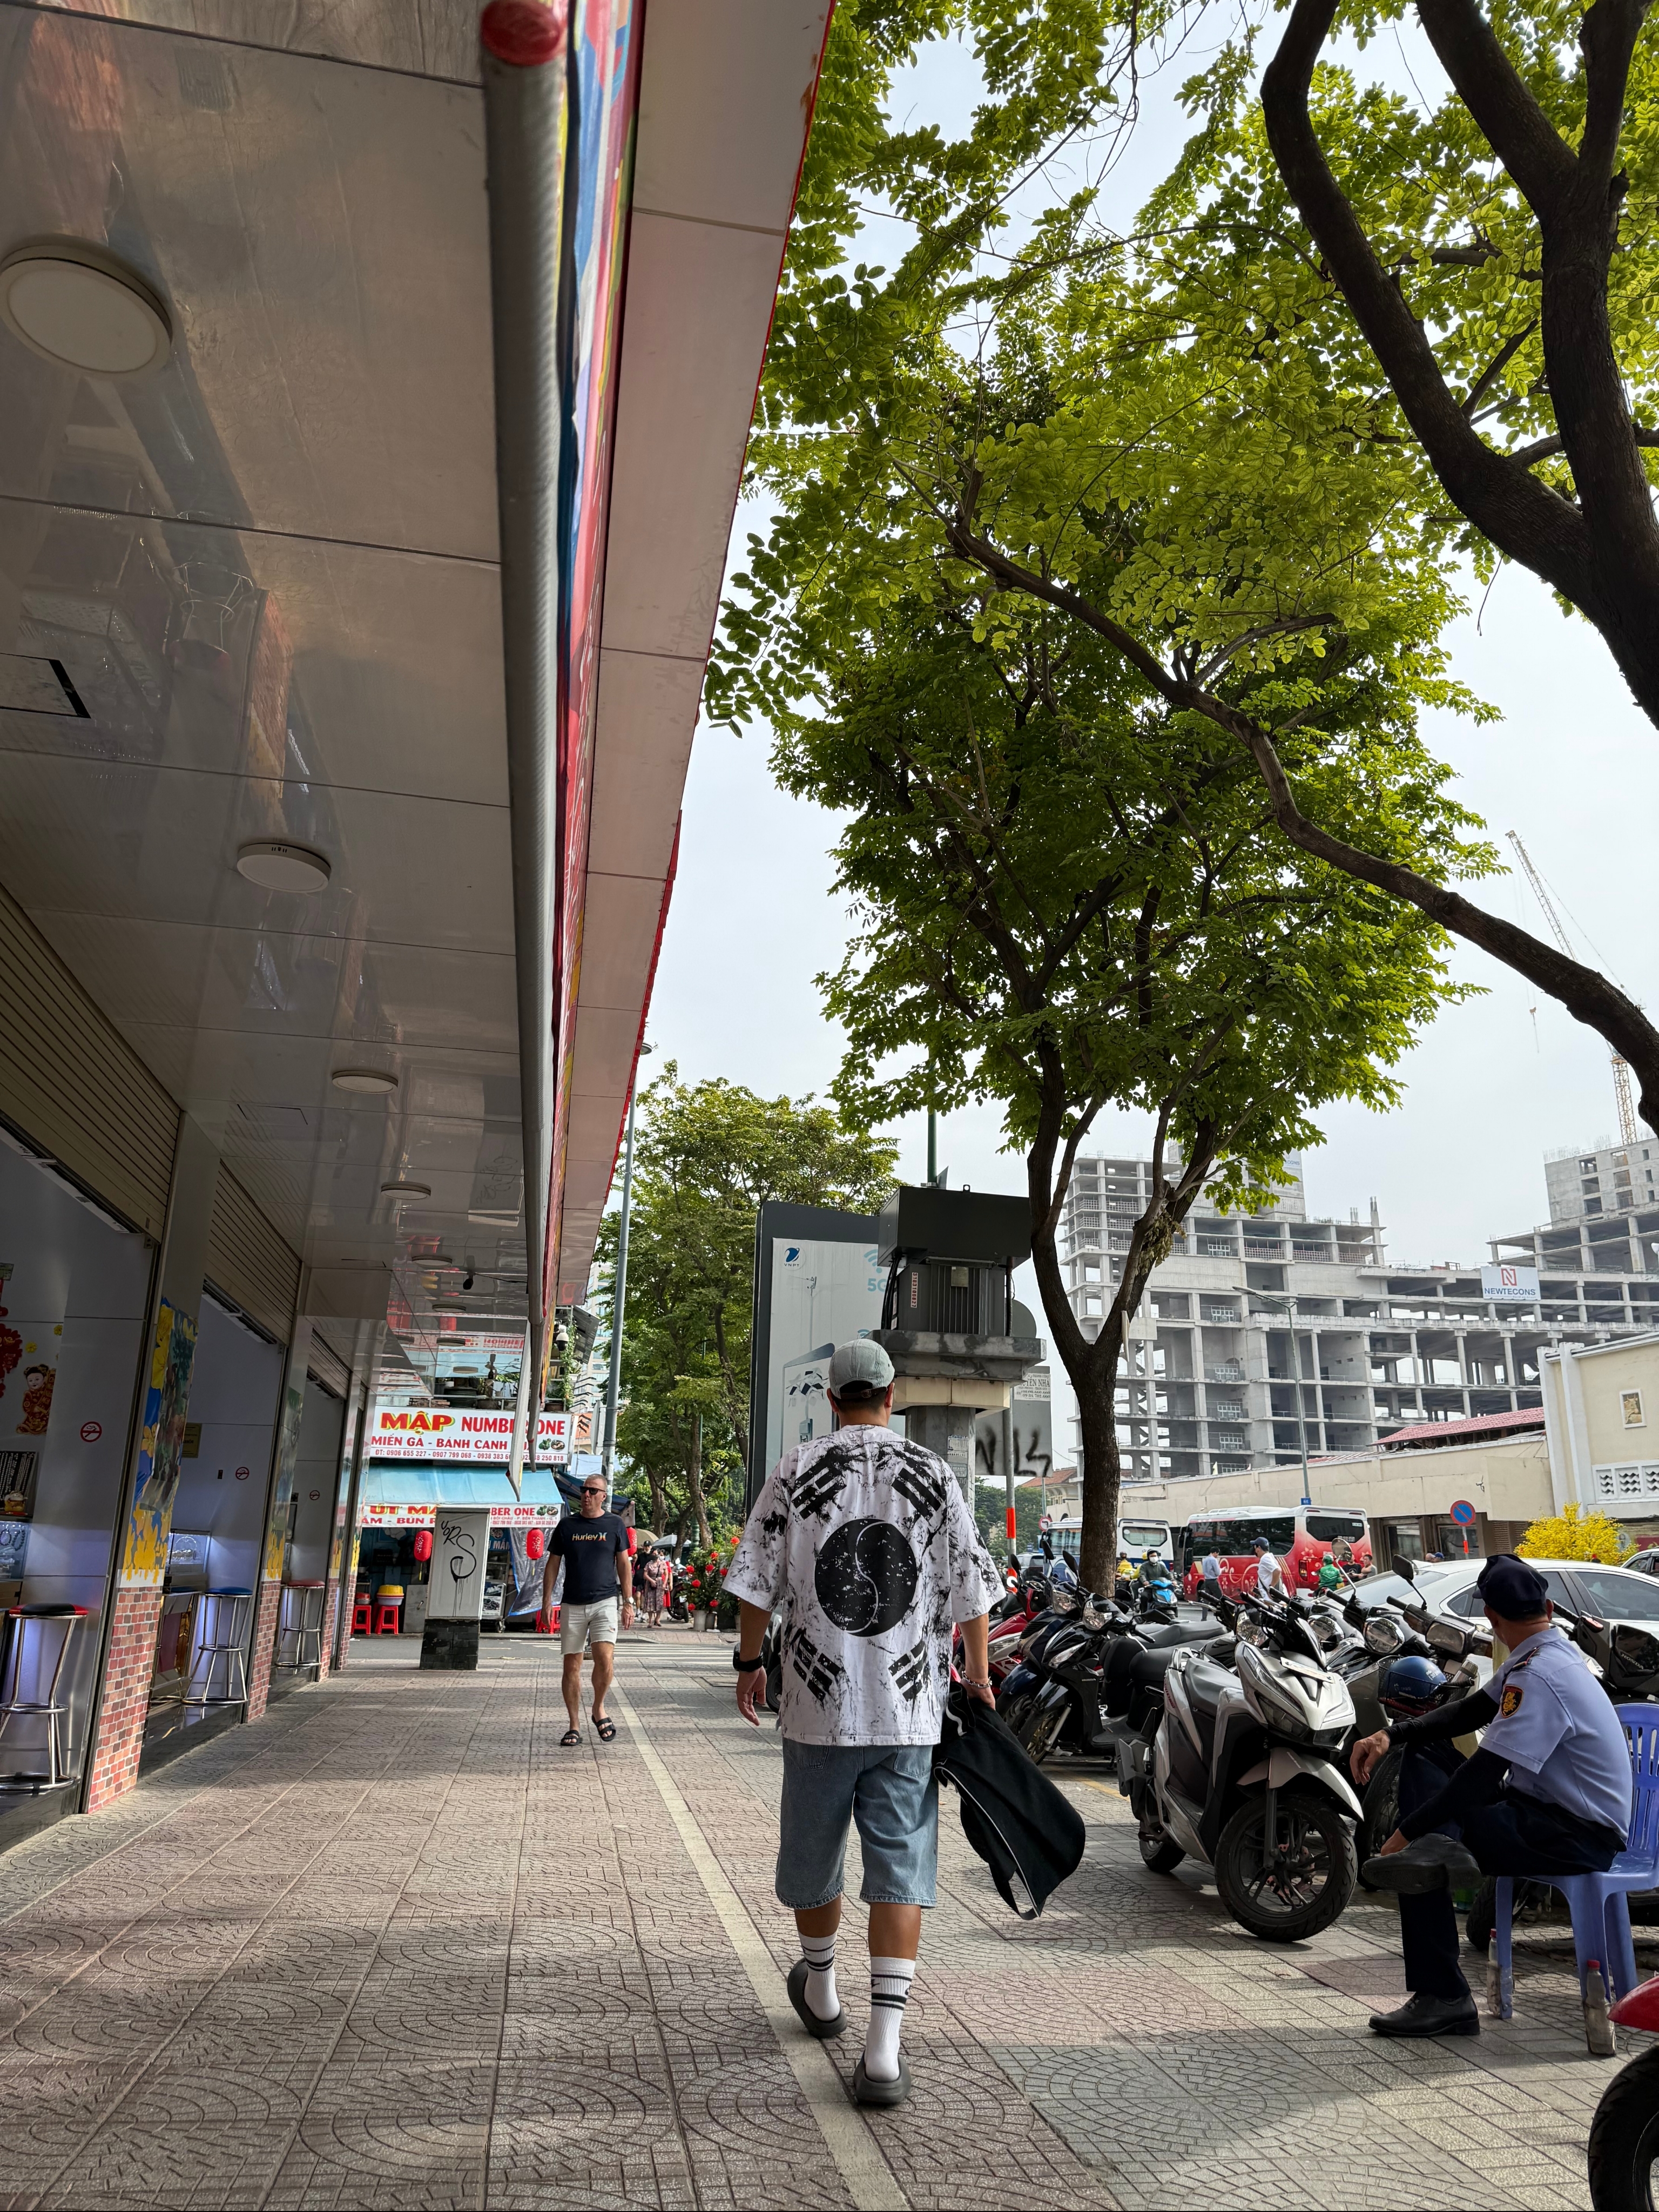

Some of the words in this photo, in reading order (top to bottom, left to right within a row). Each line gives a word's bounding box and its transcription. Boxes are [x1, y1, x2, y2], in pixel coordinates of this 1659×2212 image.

[867, 1278, 887, 1292] 5G
[1484, 1287, 1536, 1296] NEWTECONS
[380, 1411, 455, 1435] MẬP
[371, 1433, 402, 1446] MIẾN
[407, 1435, 424, 1447] GÀ
[436, 1437, 470, 1448] BÁNH
[474, 1440, 508, 1450] CANH
[514, 1507, 535, 1516] ONE
[396, 1516, 424, 1524] BÚN
[1621, 1653, 1644, 1670] HONDA
